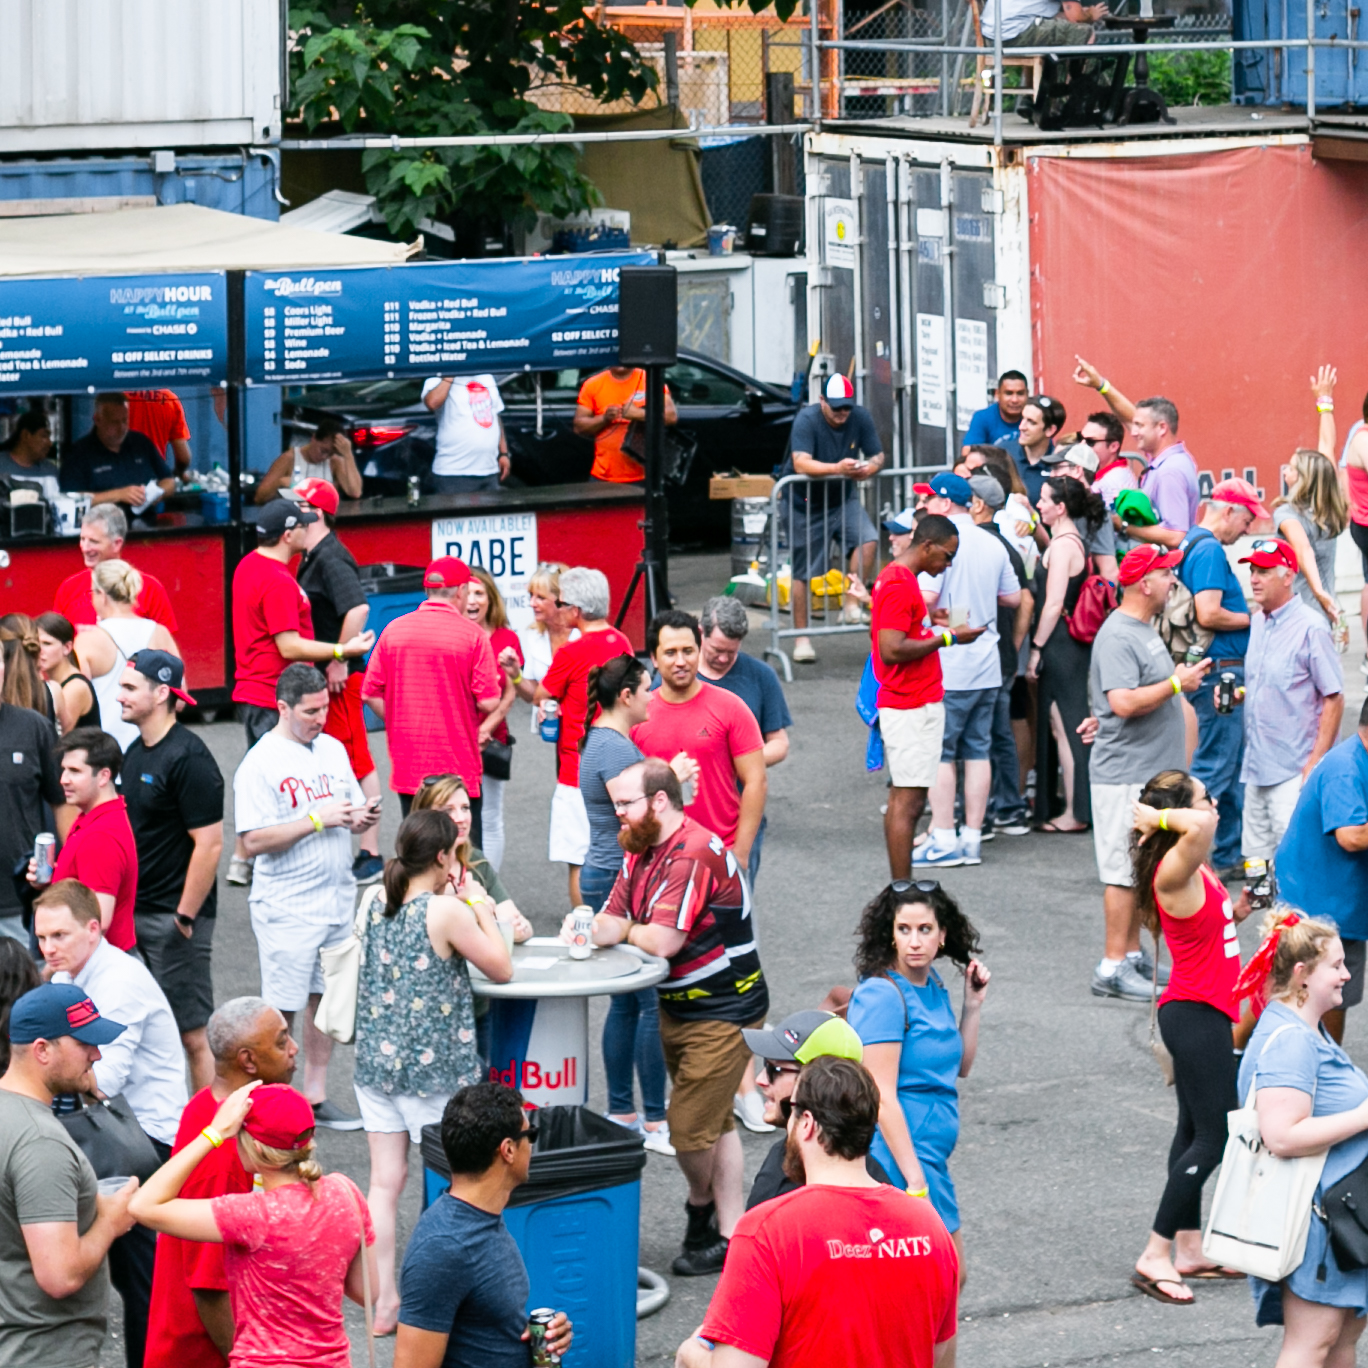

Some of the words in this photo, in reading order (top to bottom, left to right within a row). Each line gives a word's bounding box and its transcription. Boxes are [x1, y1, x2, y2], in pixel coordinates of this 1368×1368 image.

[409, 300, 436, 310] Vodka
[443, 299, 461, 309] Red
[461, 298, 478, 308] Bull
[284, 306, 309, 316] Coors
[310, 305, 332, 316] Light
[409, 311, 438, 321] Frozen
[438, 309, 465, 319] Vodka
[472, 308, 489, 318] Red
[489, 307, 507, 317] Bull
[284, 316, 309, 327] Miller
[310, 315, 333, 327] Light
[409, 321, 451, 333] Margarita
[152, 324, 186, 335] CHASE
[284, 327, 324, 338] Premium
[324, 326, 346, 336] Beer
[409, 332, 436, 342] Vodka
[443, 329, 487, 341] Lemonade
[284, 338, 308, 348] Wine
[409, 342, 436, 352] Vodka
[443, 341, 461, 351] Iced
[462, 340, 477, 350] Tea
[486, 338, 530, 349] Lemonade
[144, 350, 176, 362] SELECT
[177, 349, 213, 361] DRINKS
[284, 347, 330, 359] Lemonade
[409, 353, 440, 364] Bottled
[441, 352, 467, 362] Water
[284, 359, 307, 370] Soda
[437, 519, 464, 536] NOW
[468, 515, 532, 535] AVAILABLE!
[521, 1057, 577, 1090] Bull
[828, 1238, 873, 1260] Deez
[878, 1236, 932, 1260] NATS
